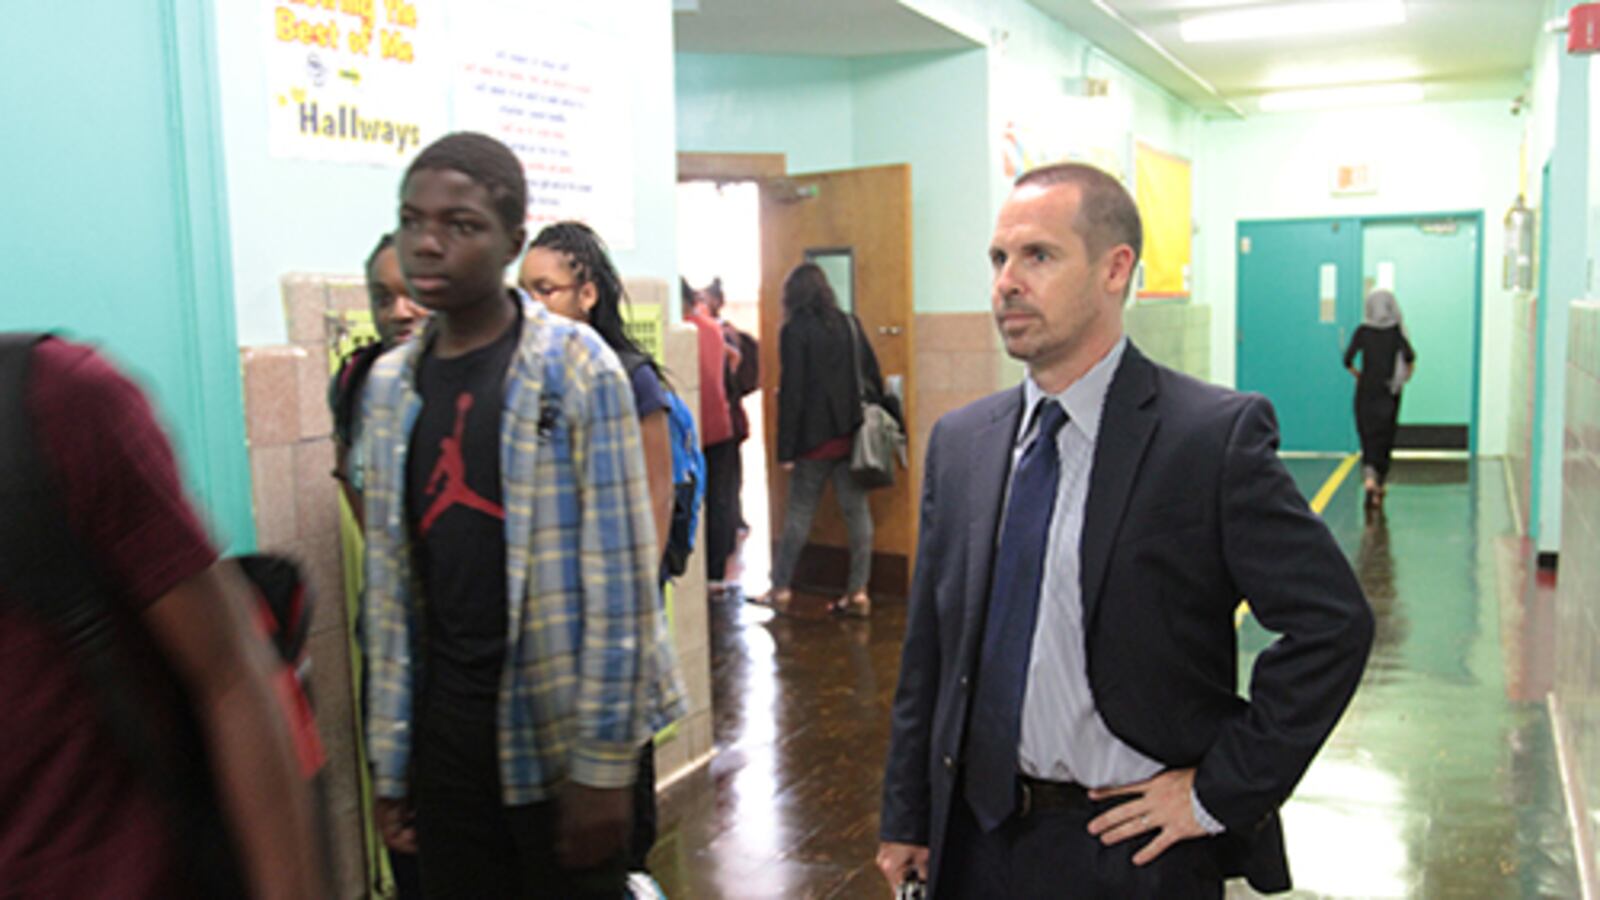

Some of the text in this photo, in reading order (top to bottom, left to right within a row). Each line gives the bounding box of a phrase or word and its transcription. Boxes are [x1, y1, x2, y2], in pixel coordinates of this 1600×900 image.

[274, 6, 415, 63] Best of Me
[298, 101, 420, 153] Hallways
